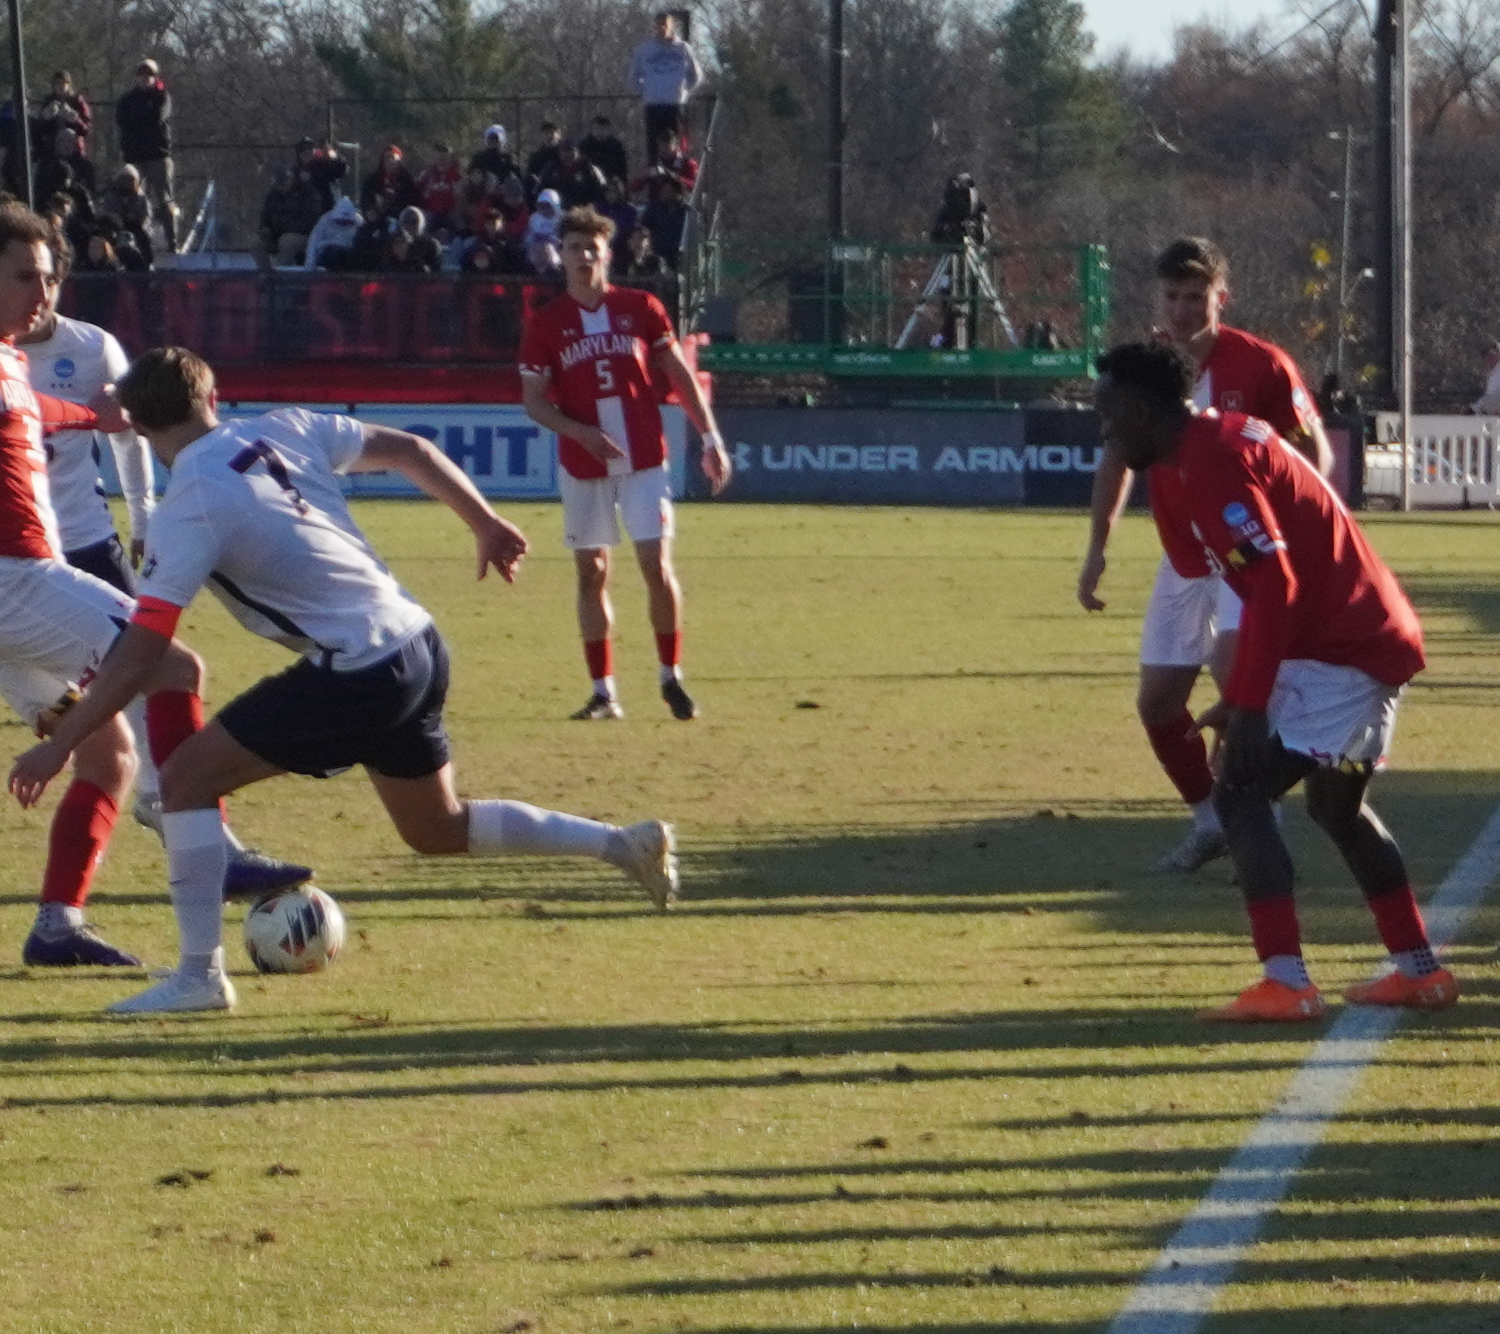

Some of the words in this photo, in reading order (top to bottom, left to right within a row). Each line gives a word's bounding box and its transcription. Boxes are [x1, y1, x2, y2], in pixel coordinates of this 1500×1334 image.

[595, 357, 615, 390] 5
[761, 445, 920, 472] UNDER
[932, 445, 1102, 473] ARMOU
